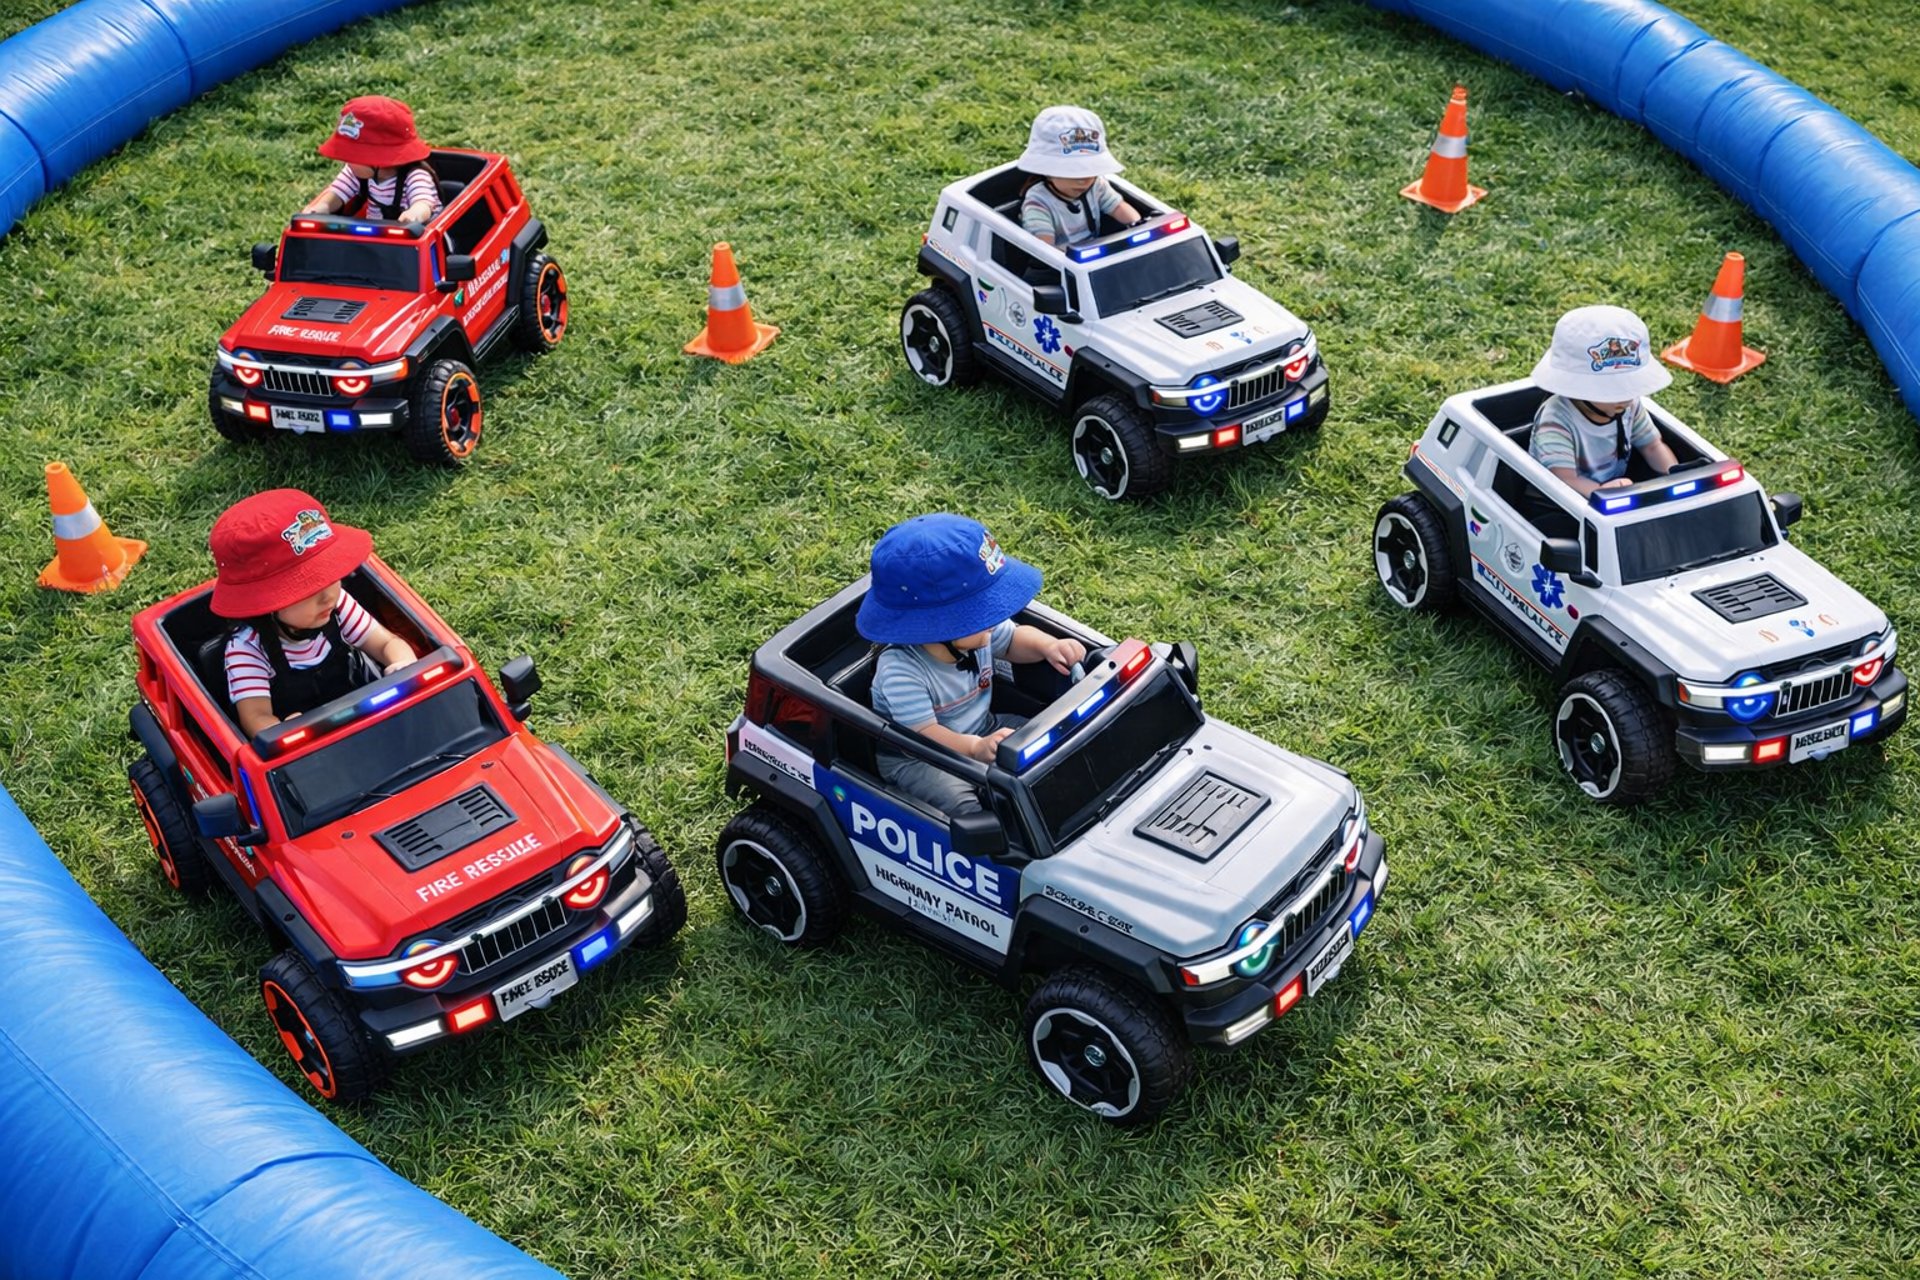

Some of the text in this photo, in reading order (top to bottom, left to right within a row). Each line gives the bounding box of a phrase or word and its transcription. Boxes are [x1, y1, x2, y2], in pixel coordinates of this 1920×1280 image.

[851, 801, 1001, 904] POLICE
[416, 872, 463, 902] FIRE
[945, 902, 999, 937] PATROL
